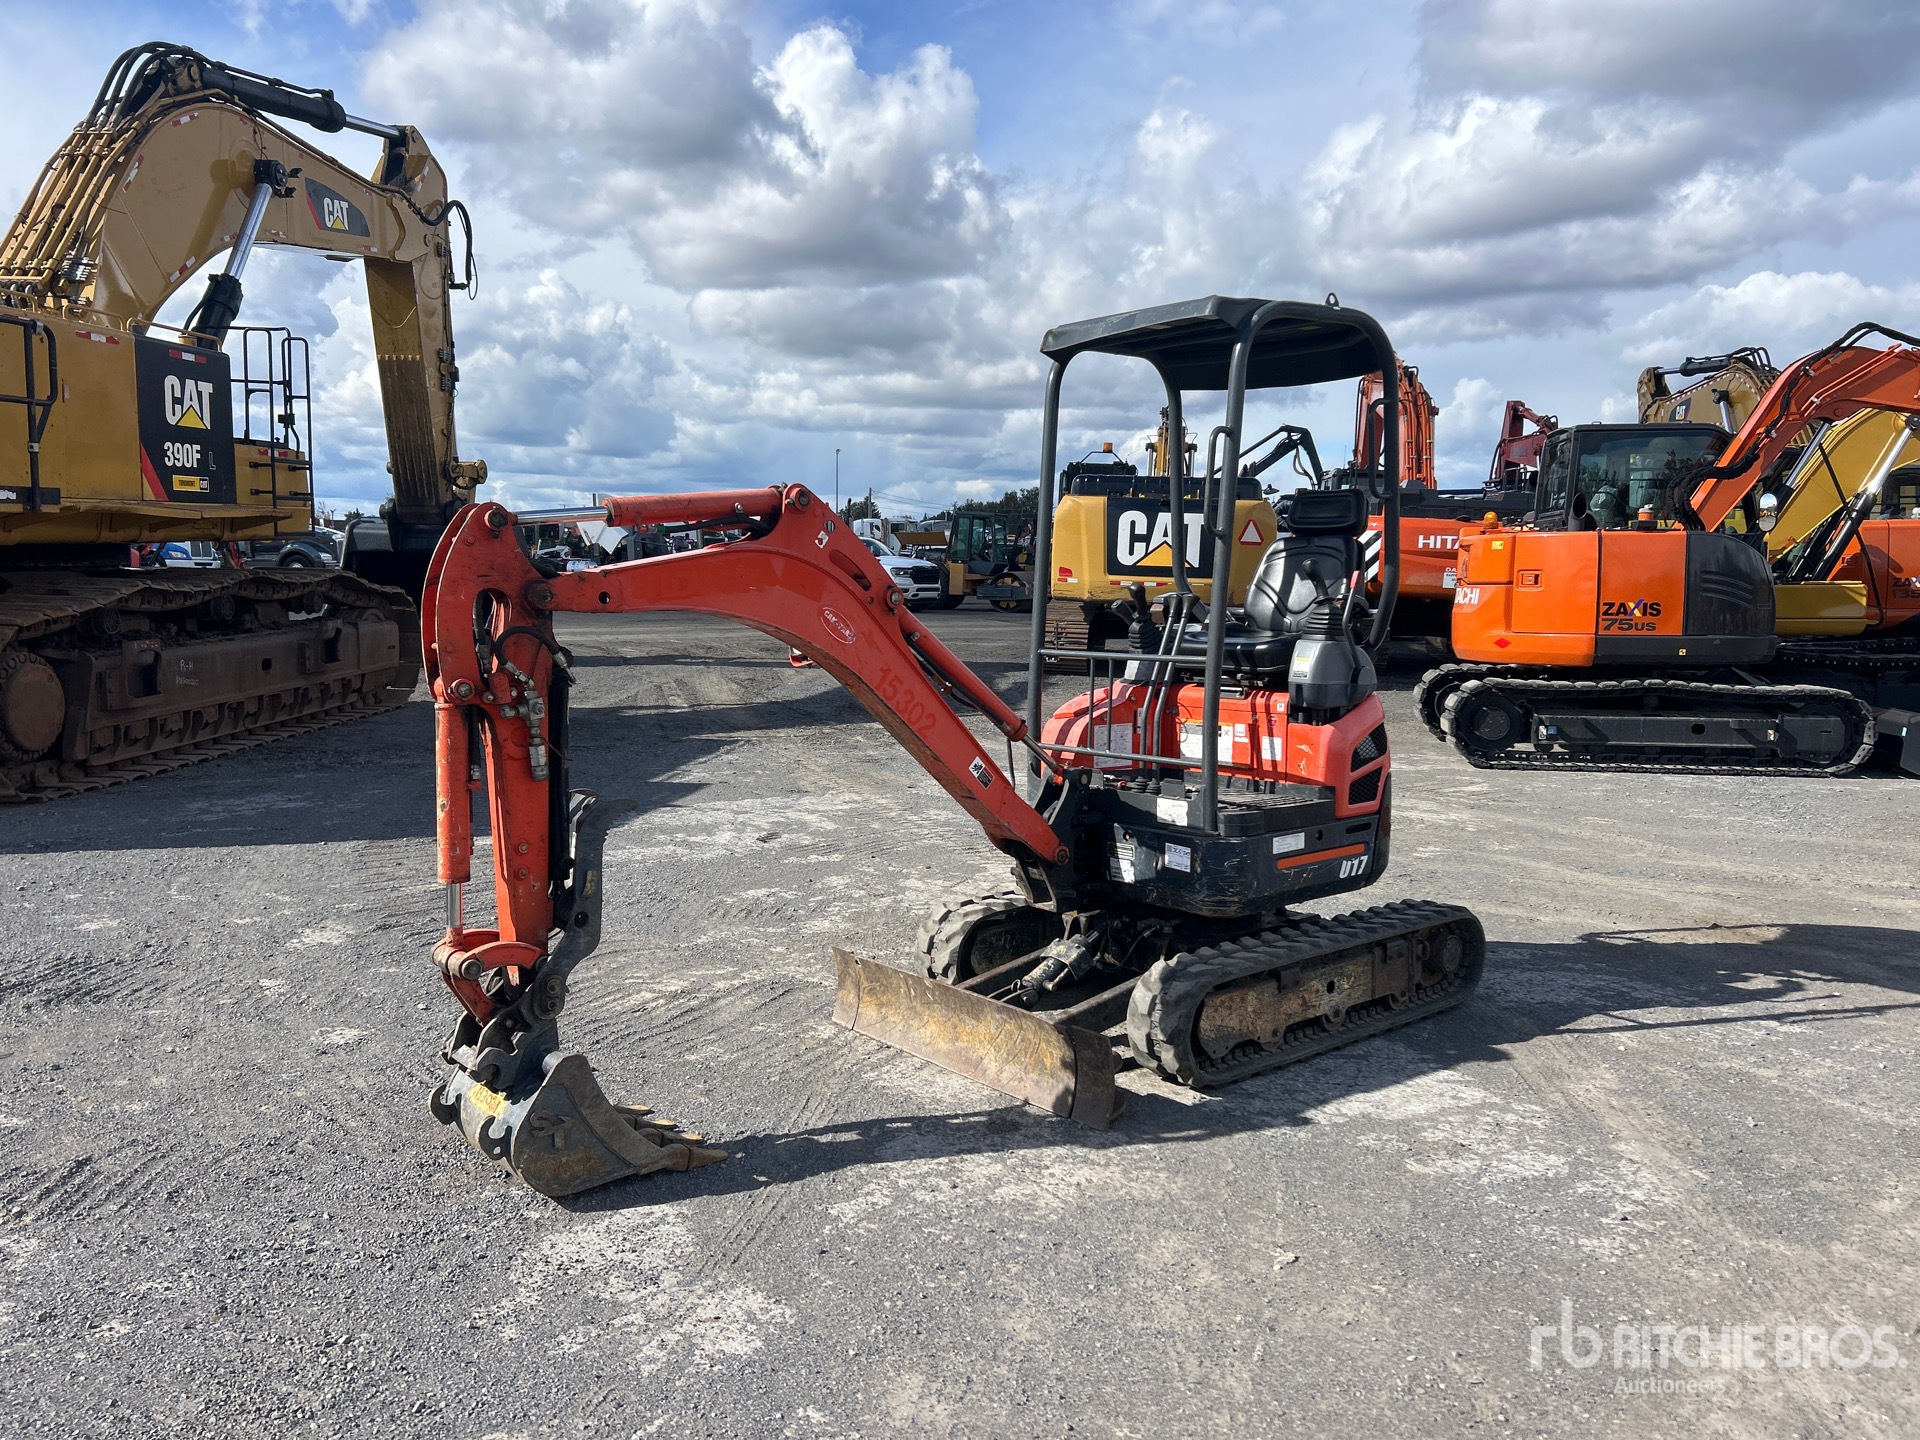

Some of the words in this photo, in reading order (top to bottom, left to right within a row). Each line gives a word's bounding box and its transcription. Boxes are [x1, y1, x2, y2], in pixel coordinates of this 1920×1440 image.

[323, 197, 349, 230] CAT
[164, 374, 213, 430] CAT
[163, 441, 201, 468] 390F
[1116, 510, 1205, 568] CAT
[1601, 598, 1662, 617] ZAXIS
[1602, 618, 1657, 632] 75US
[873, 664, 937, 741] 15302
[1339, 855, 1369, 879] U17
